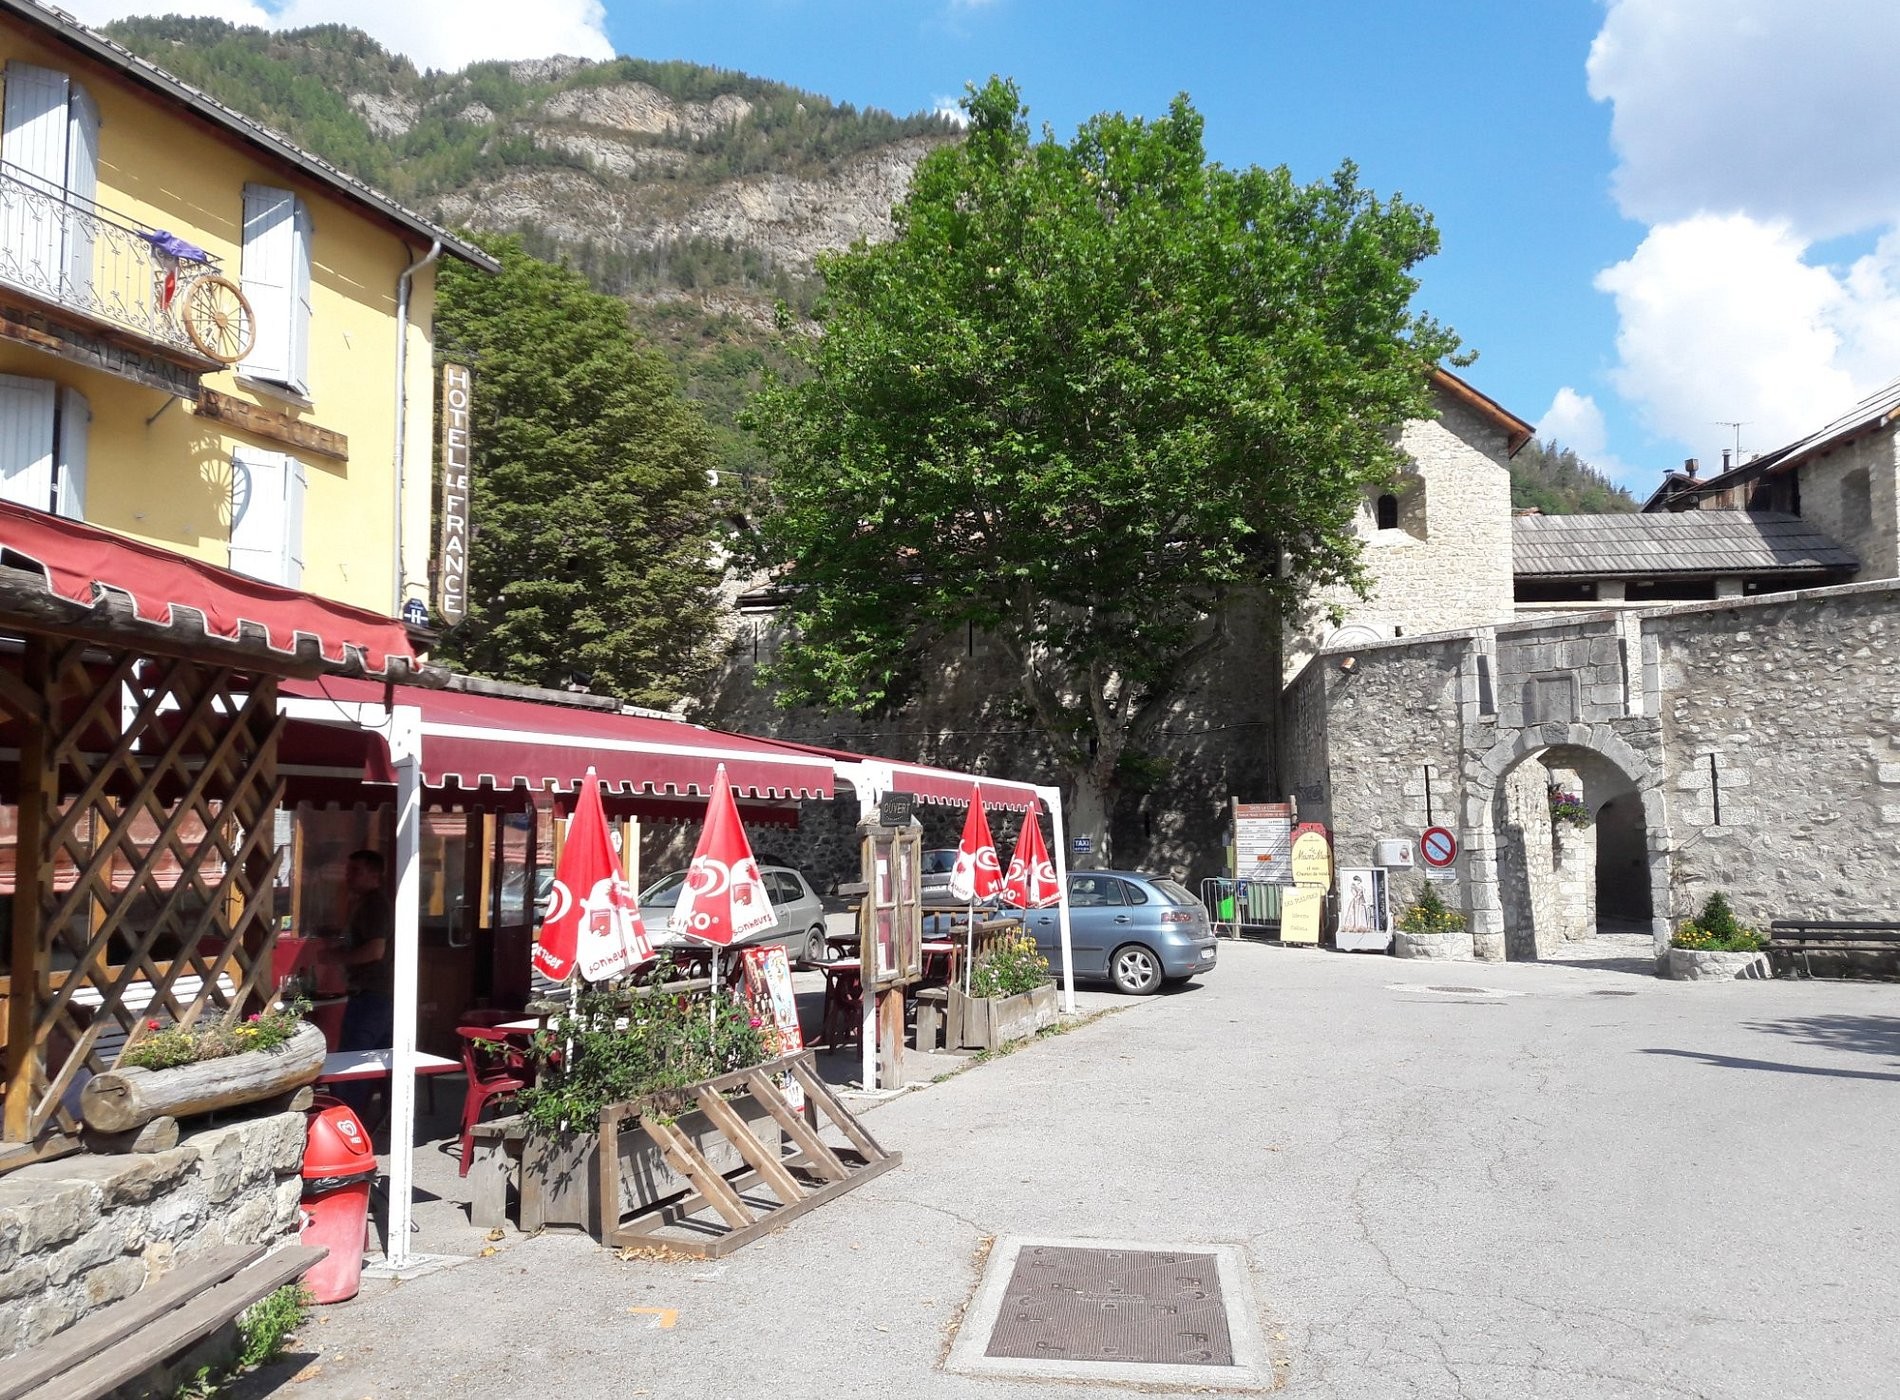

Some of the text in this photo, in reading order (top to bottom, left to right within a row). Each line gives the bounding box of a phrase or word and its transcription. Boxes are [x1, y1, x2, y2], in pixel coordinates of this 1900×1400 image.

[204, 389, 250, 427] BAR
[444, 367, 468, 614] HOTEL LE FRANCE
[883, 802, 911, 814] OUVERT
